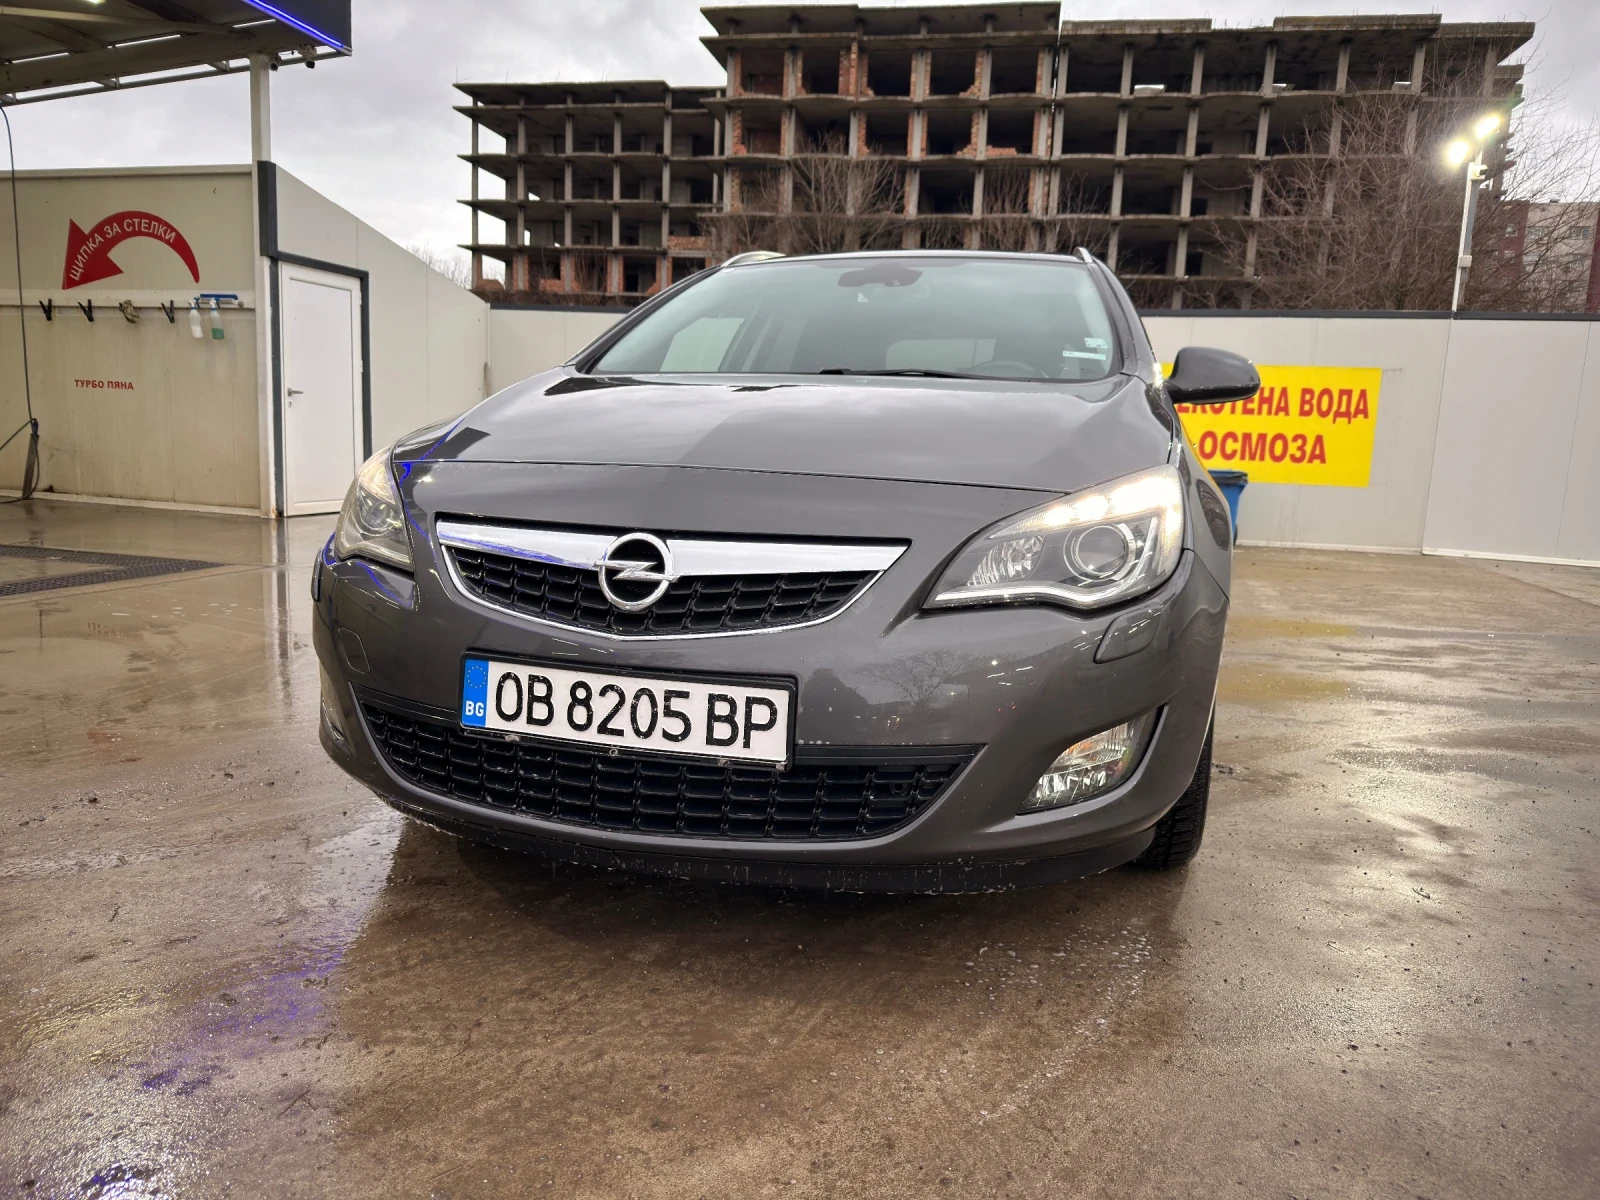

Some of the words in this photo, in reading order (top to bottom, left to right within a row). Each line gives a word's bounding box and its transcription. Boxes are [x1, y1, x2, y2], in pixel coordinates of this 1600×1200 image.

[69, 233, 105, 281] ЩИПКА
[103, 222, 122, 238] ЗА
[123, 218, 176, 243] СТЕЛКИ
[74, 379, 104, 389] ТУРБО
[107, 381, 134, 390] ПЯНА
[1298, 387, 1369, 424] ВОДА
[1198, 430, 1327, 464] ОСМОЗА
[465, 701, 484, 717] BG
[495, 671, 555, 727] OB
[566, 680, 692, 743] 8205
[705, 693, 778, 749] BP
